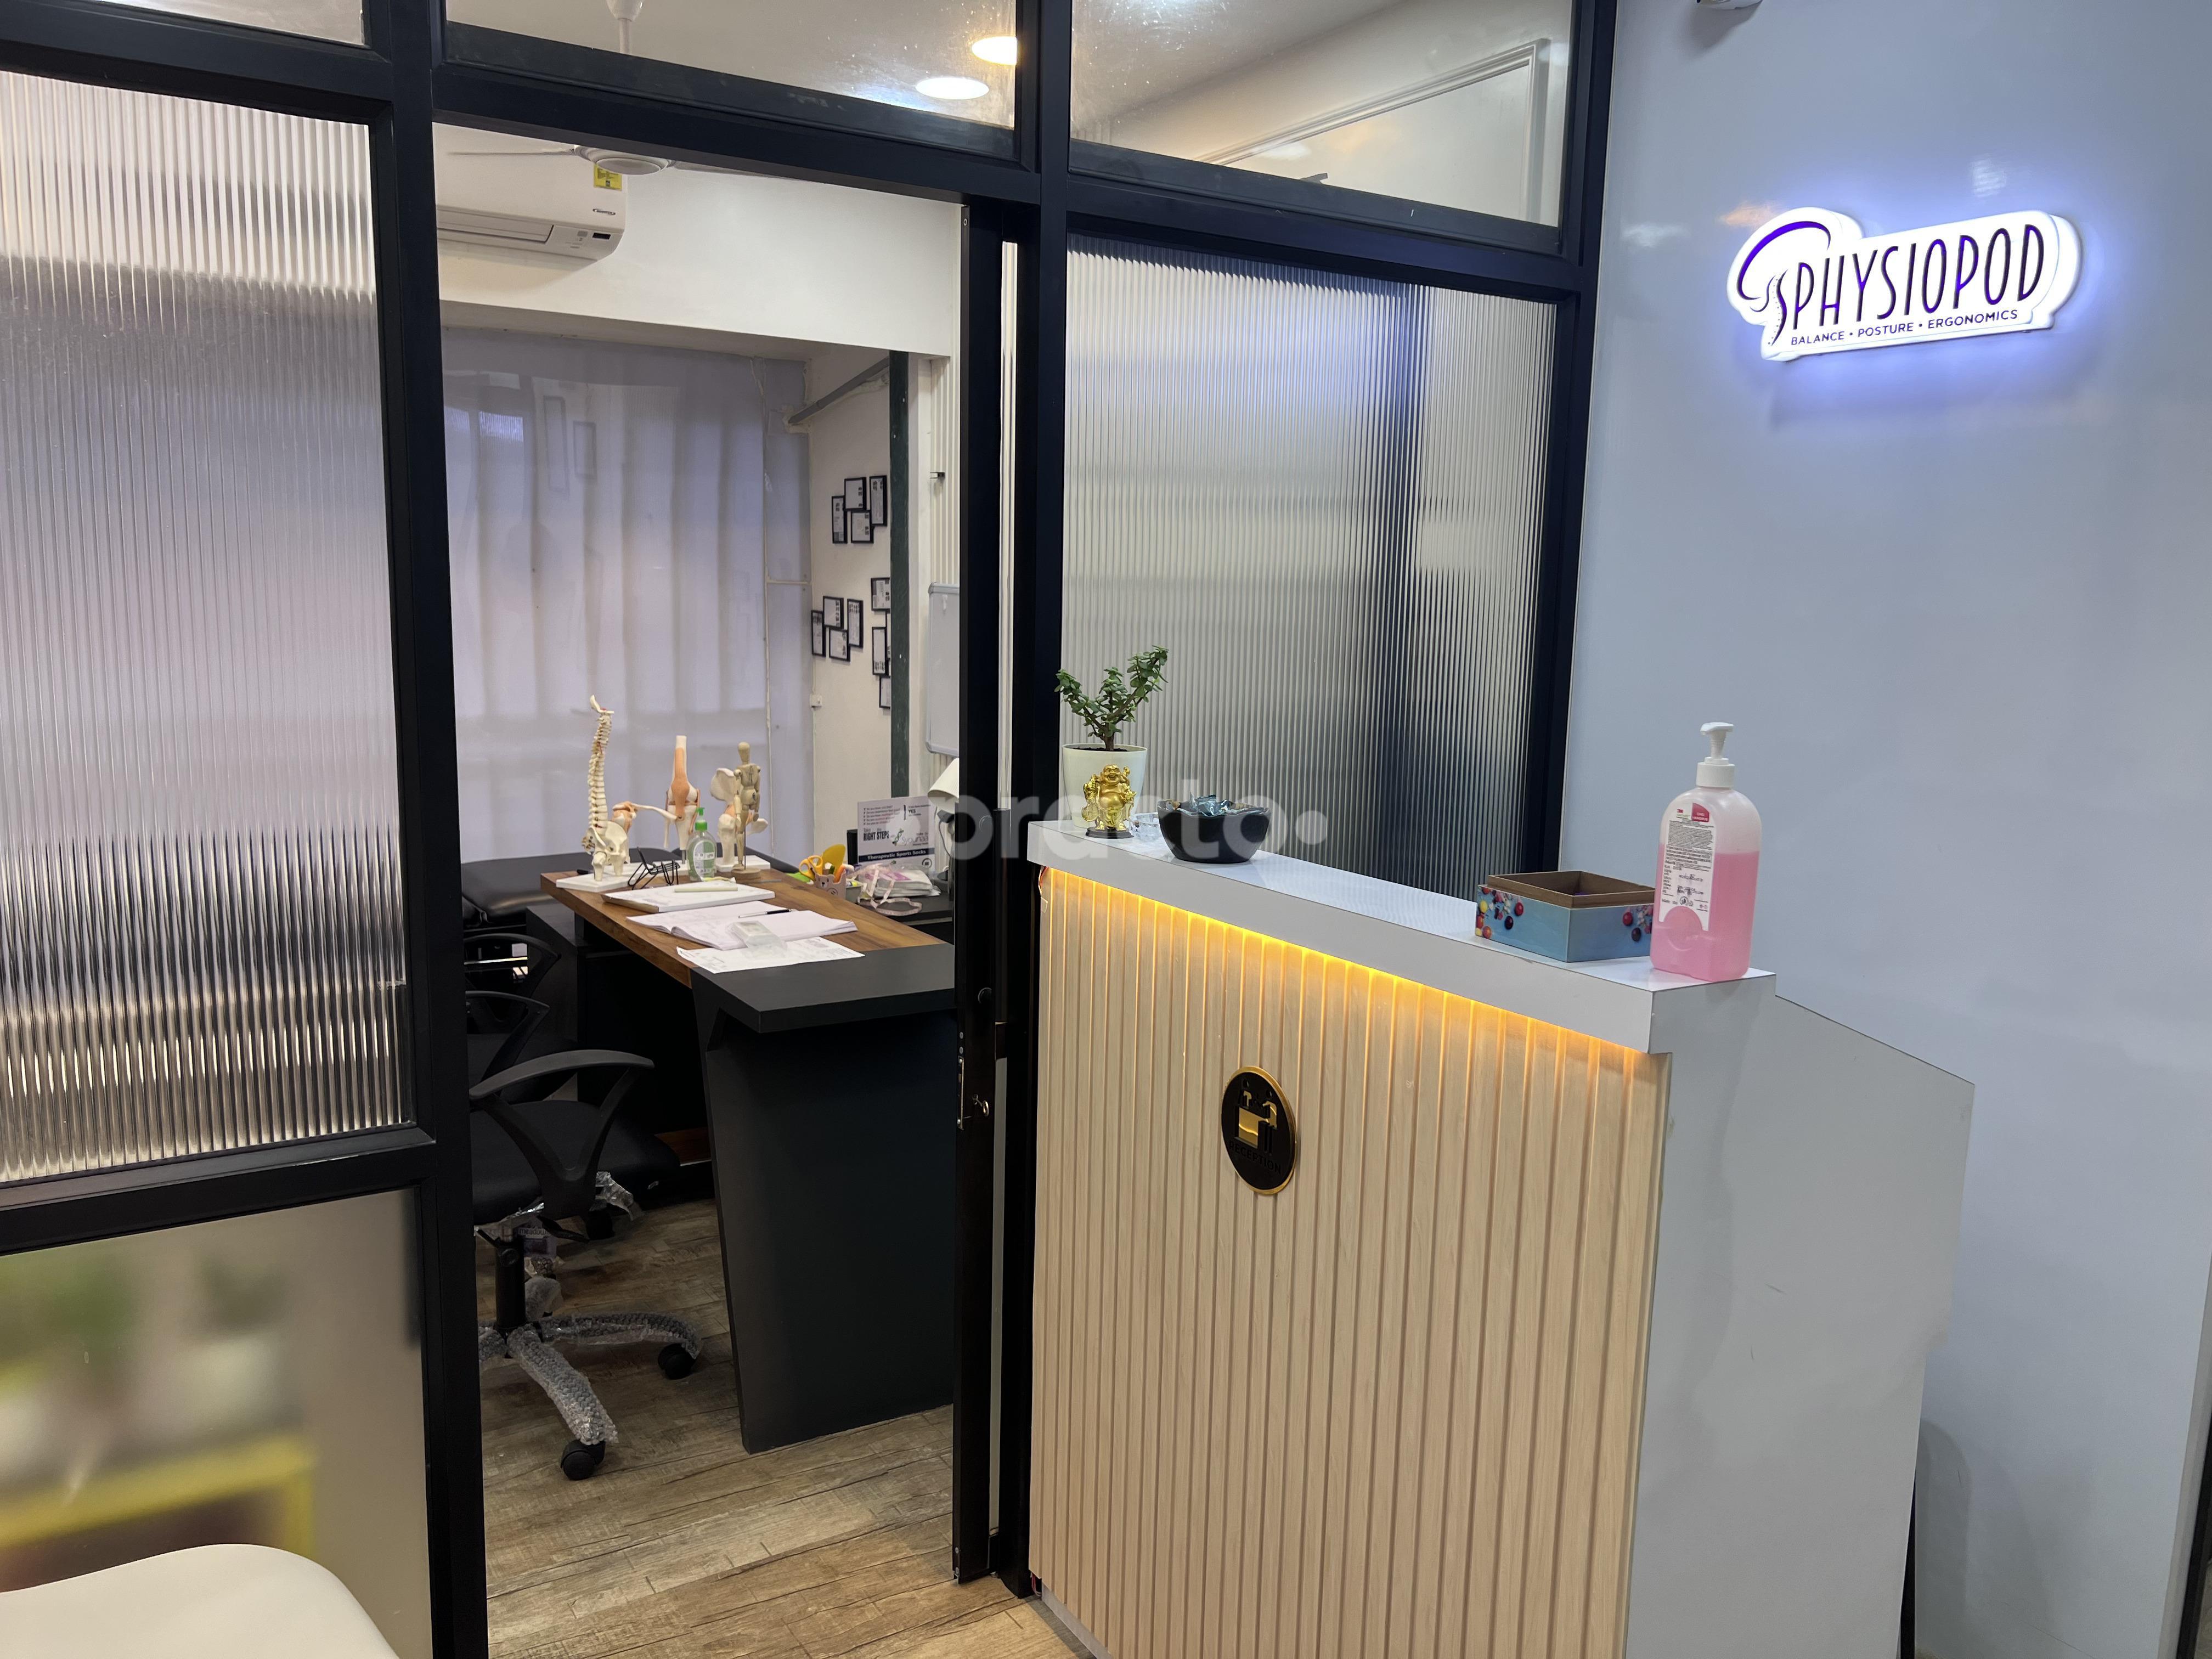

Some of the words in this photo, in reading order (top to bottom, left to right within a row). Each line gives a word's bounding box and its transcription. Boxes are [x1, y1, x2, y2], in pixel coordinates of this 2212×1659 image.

[1793, 224, 2045, 330] PHYSIOPOD
[1791, 331, 1845, 346] BALANCE
[1858, 322, 1914, 338] POSTURE
[1927, 309, 2018, 329] ERGONOMICS
[863, 832, 876, 841] RIGHT
[877, 831, 889, 840] STEPS
[1229, 1140, 1282, 1175] RECEPTION
